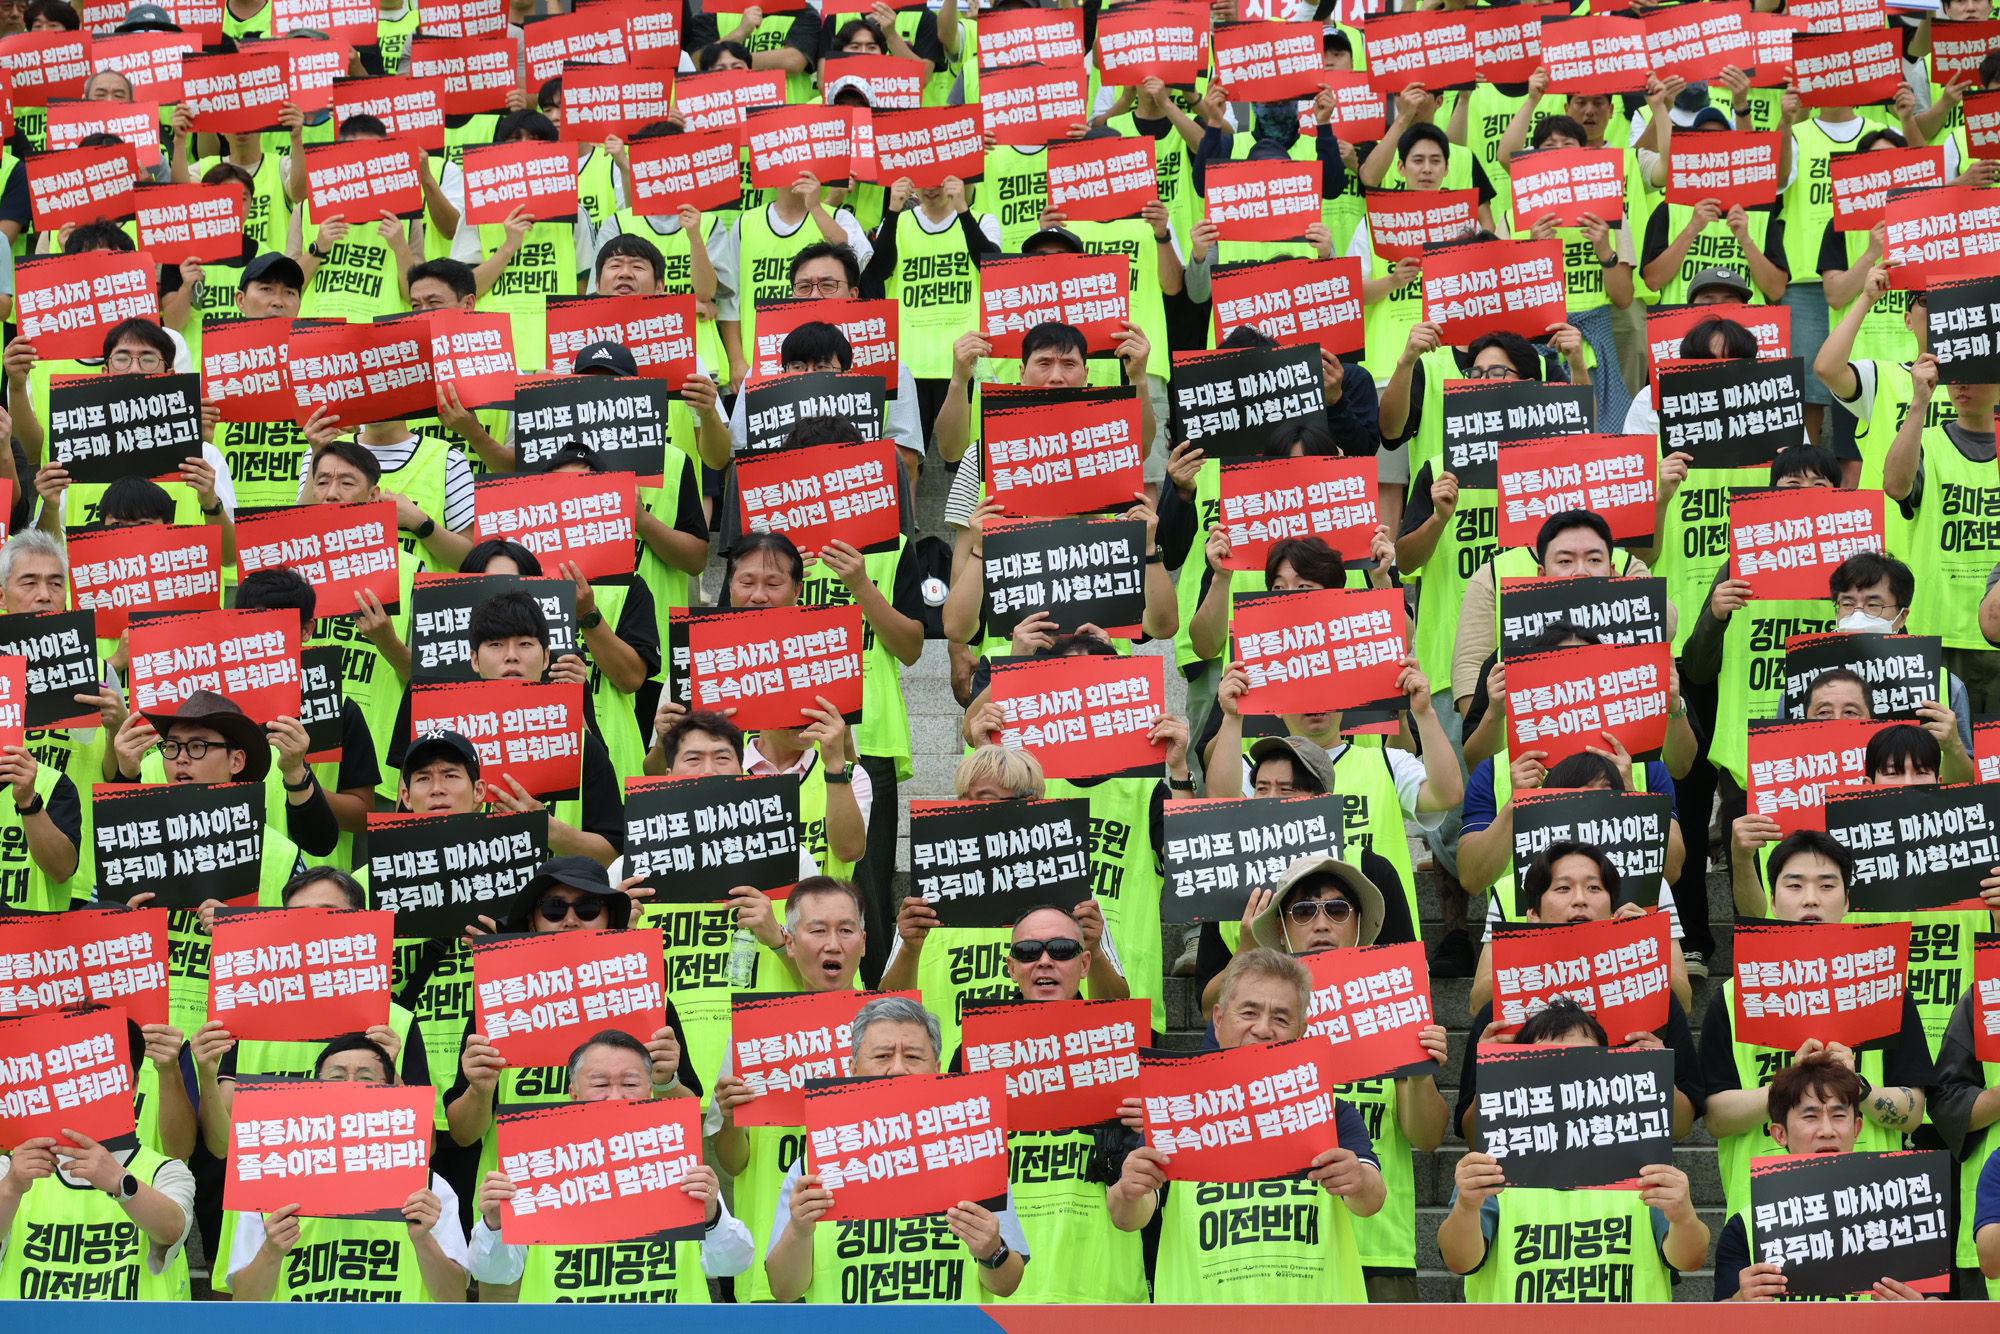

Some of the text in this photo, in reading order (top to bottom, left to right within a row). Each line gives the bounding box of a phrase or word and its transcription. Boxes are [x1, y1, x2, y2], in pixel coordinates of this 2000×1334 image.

[1100, 27, 1193, 51] 말종사자 외면한
[1103, 45, 1197, 69] 졸속이전 멈춰라!
[1795, 42, 1893, 74] 말종사자 외면한
[1798, 59, 1900, 92] 졸속이전 멈춰라!
[751, 120, 845, 152] 말종사자 외면한
[755, 139, 849, 170] 졸속이전 멈춰라!
[876, 118, 974, 151] 말종사자 외면한
[880, 136, 982, 169] 졸속이전 멈춰라!
[310, 152, 409, 187] 말종사자 외면한
[1050, 151, 1147, 184] 말종사자 외면한
[1672, 146, 1771, 169] 말종사자 외면한
[1673, 164, 1775, 188] 졸속이전 멈춰라!
[313, 170, 419, 207] 졸속이전 멈춰라!
[998, 171, 1047, 201] 경마공
[1052, 169, 1154, 204] 졸속이전 멈춰라!
[1208, 175, 1312, 204] 말종사자 외면한
[138, 198, 233, 226] 말종사자 외면한
[142, 216, 239, 245] 졸속이전 멈춰라!
[1210, 194, 1319, 223] 졸속이전 멈춰라!
[315, 270, 383, 298] 이전반대
[902, 252, 970, 282] 경마공원
[903, 280, 973, 309] 이전반대
[290, 340, 419, 381] 말종사자 외면한
[294, 362, 432, 406] 졸속이전 멈춰라!
[1178, 361, 1318, 410] 무대포 마사이전,
[1663, 375, 1800, 418] 무대포 마사이전,
[52, 390, 194, 434] 무대포 마사이전,
[1183, 388, 1324, 439] 경주마 사형선고!
[1666, 402, 1803, 447] 경주마 사형선고!
[54, 418, 199, 464] 경주마 사형선고!
[989, 419, 1128, 464] 말종사자 외면한
[743, 461, 883, 511] 말종사자 외면한
[993, 444, 1140, 491] 졸속이전 멈춰라!
[750, 485, 896, 534] 졸속이전 멈춰라!
[1941, 483, 2000, 518] 경마공
[72, 545, 208, 588] 말종사자 외면한
[985, 538, 1138, 583] 무대포 마사이전,
[78, 571, 218, 612] 졸속이전 멈춰라!
[931, 585, 938, 594] 6
[989, 569, 1141, 614] 경주마 사형선고!
[694, 627, 847, 675] 말종사자 외면한
[699, 654, 860, 704] 졸속이전 멈춰라!
[1510, 664, 1657, 715] 말종사자 외면한
[1516, 691, 1666, 743] 졸속이전 멈춰라!
[97, 803, 258, 852] 무대포 마사이전,
[627, 795, 792, 845] 무대포 마사이전,
[102, 835, 260, 885] 경주마 사형선고!
[630, 826, 796, 878] 경주마 사형선고!
[914, 819, 1082, 870] 무대포 마사이전,
[918, 850, 1087, 903] 경주마 사형선고!
[214, 934, 376, 980] 말종사자 외면한
[1738, 945, 1900, 987] 말종사자 외면한
[215, 974, 305, 1010] 졸속이전
[310, 964, 388, 998] 멈춰라!
[479, 952, 647, 1009] 말종사자 외면한
[1743, 974, 1902, 1017] 졸속이전 멈춰라!
[484, 982, 662, 1040] 졸속이전 멈춰라!
[1146, 1064, 1326, 1123] 말종사자 외면한
[1479, 1071, 1666, 1121] 무대포 마사이전,
[236, 1109, 416, 1148] 말종사자 외면한
[811, 1096, 990, 1157] 말종사자 외면한
[1152, 1093, 1333, 1154] 졸속이전 멈춰라!
[1483, 1107, 1669, 1158] 경주마 사형선고!
[237, 1140, 425, 1181] 졸속이전 멈춰라!
[818, 1127, 1004, 1190] 졸속이전 멈춰라!
[1755, 1173, 1941, 1233] 무대포 마사이전,
[25, 1221, 140, 1264] 경마공원
[1199, 1203, 1320, 1252] 이전반대
[1514, 1215, 1632, 1265] 경마공원
[1760, 1209, 1947, 1268] 경주마 사형선고!
[286, 1239, 399, 1289] 경마공원
[554, 1241, 678, 1290] 경마공원
[841, 1259, 964, 1303] 이전반대
[1514, 1263, 1634, 1303] 이전반대
